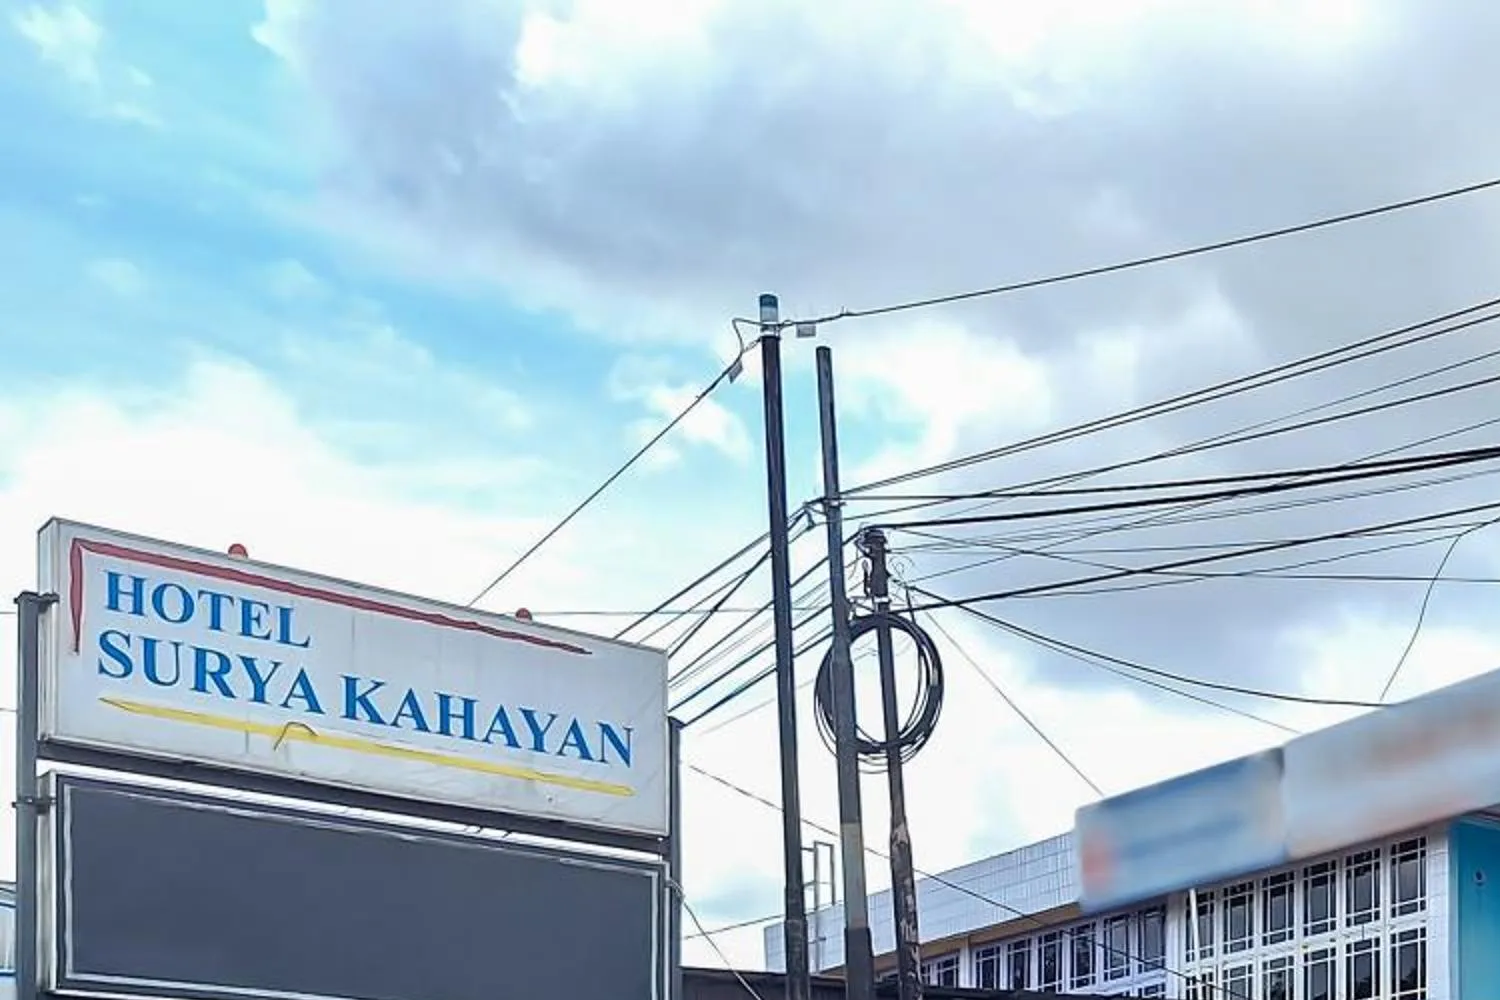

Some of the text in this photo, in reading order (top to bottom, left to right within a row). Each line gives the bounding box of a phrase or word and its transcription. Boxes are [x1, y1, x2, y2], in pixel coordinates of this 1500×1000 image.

[105, 571, 311, 648] HOTEL
[98, 629, 634, 768] SURYA KAHAYAN
